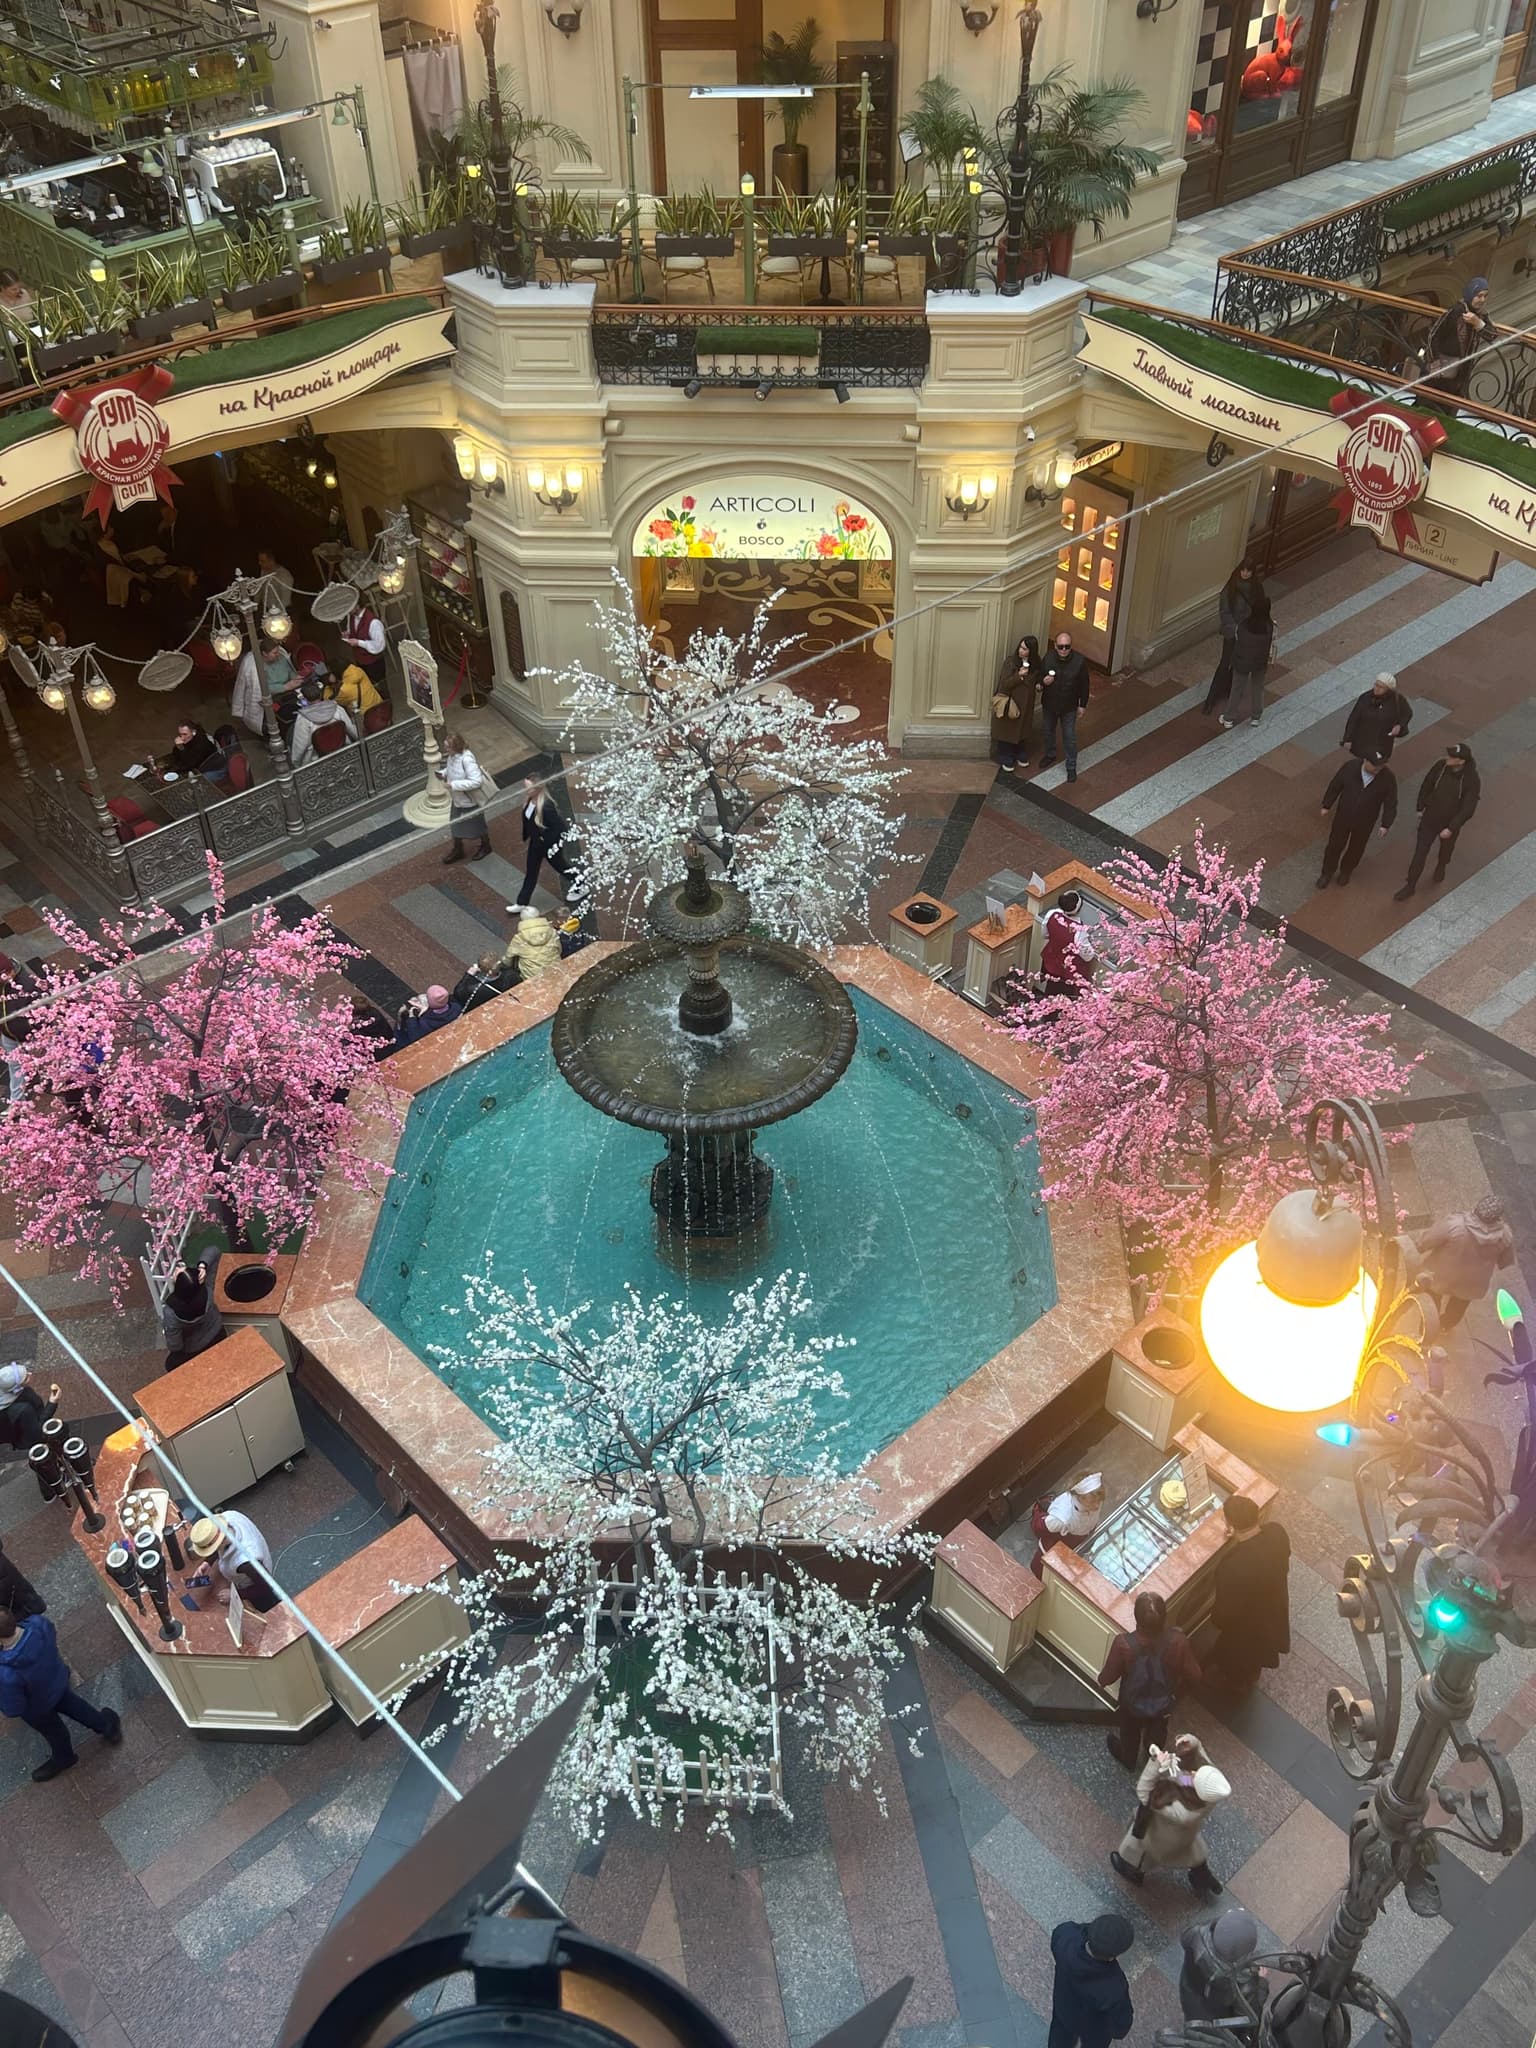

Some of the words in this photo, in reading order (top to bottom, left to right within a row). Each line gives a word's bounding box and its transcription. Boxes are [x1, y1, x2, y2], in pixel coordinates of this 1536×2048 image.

[219, 400, 247, 415] на
[254, 370, 334, 411] Красной
[337, 342, 401, 383] площади
[1133, 348, 1193, 399] Главный
[1200, 394, 1281, 432] магазин
[98, 395, 137, 427] ГУМ
[1367, 419, 1403, 454] ГУМ
[96, 466, 131, 483] КРАСНАЯ
[133, 448, 163, 480] ПЛОЩАДЬ
[1072, 446, 1115, 472] РТИКОЛИ
[121, 481, 149, 499] GUM
[1344, 472, 1370, 505] КРАСНАЯ
[1371, 494, 1407, 509] ПЛОЩАДЬ
[1368, 480, 1383, 490] 1893
[709, 497, 815, 513] ARTICOLI
[1488, 492, 1510, 515] на
[1357, 505, 1383, 527] GUM
[739, 536, 785, 546] BOSCO
[1430, 529, 1441, 543] 2
[1440, 553, 1459, 566] LINE
